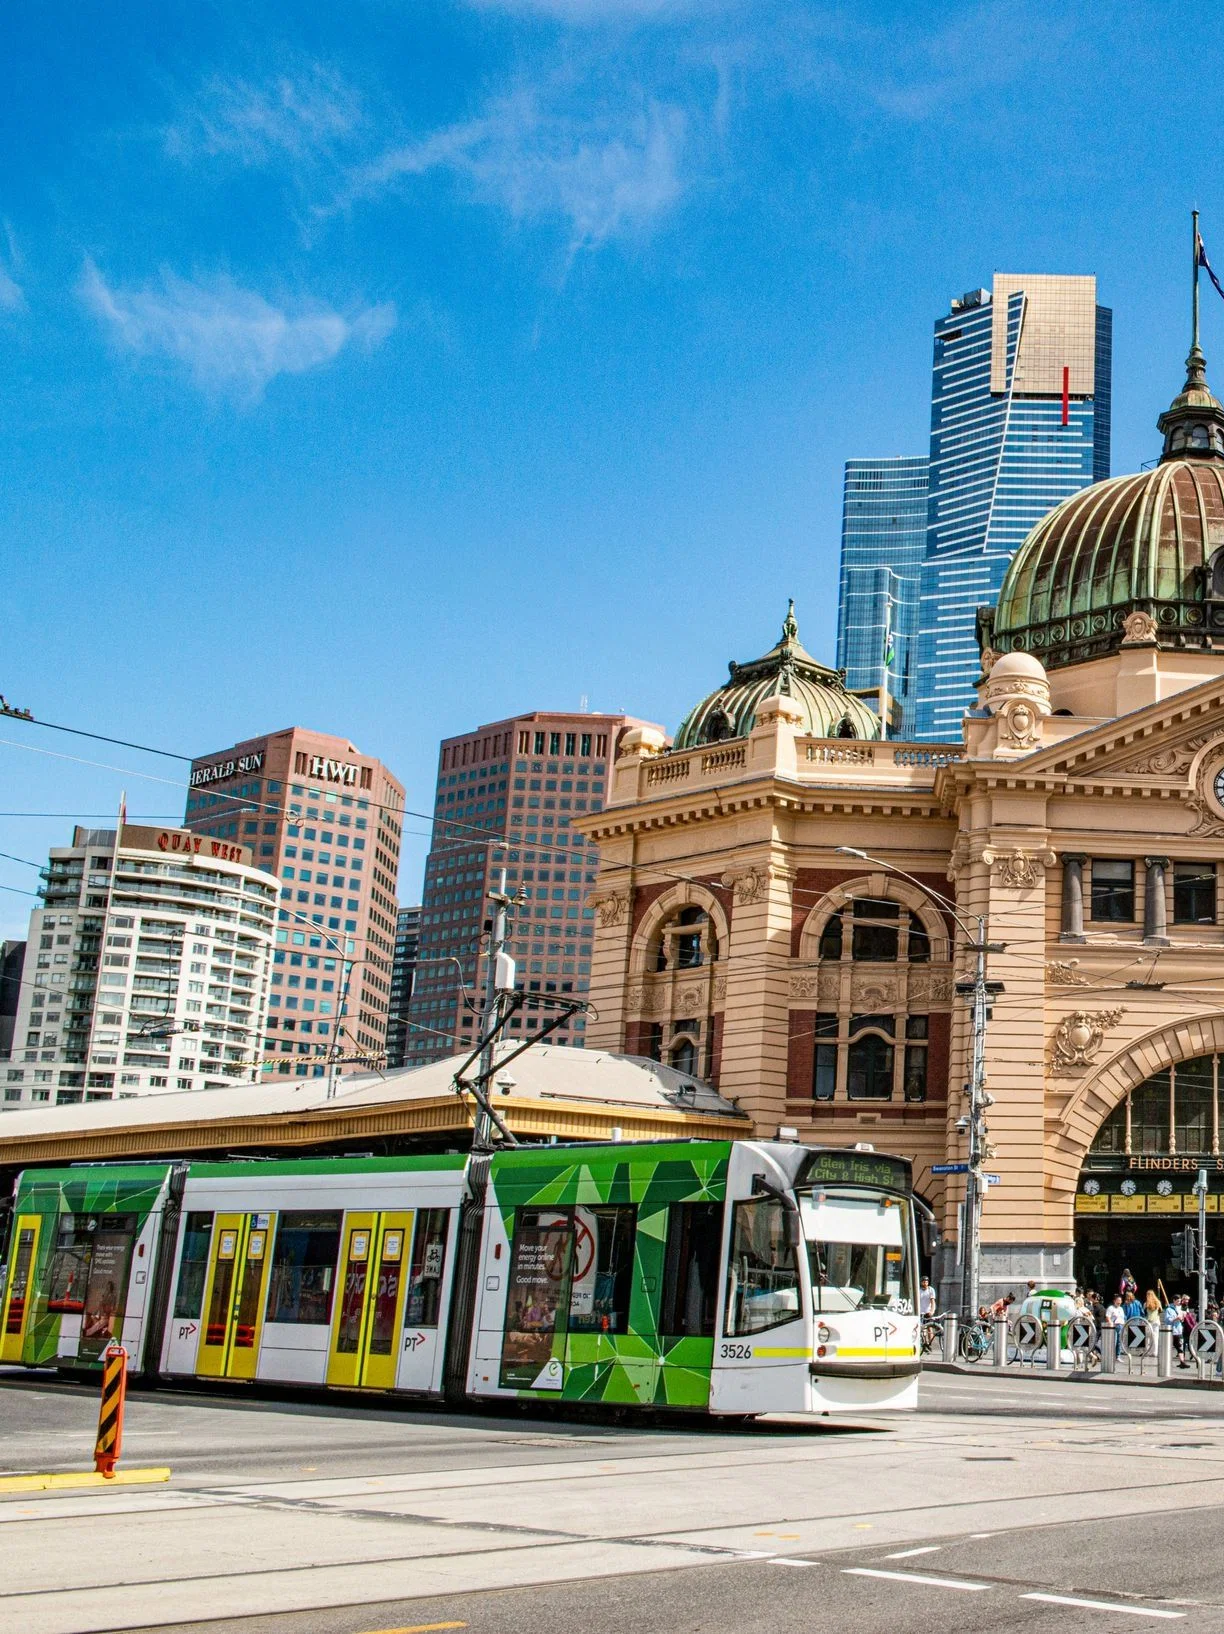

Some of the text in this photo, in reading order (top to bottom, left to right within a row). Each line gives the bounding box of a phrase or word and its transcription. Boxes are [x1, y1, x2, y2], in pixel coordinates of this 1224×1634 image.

[190, 753, 263, 786] HERALD SUN
[312, 757, 359, 783] HWT
[158, 833, 242, 863] QUAY WEST
[820, 1157, 891, 1174] Glen Iris via
[1129, 1158, 1198, 1170] FLINDERS
[814, 1168, 837, 1180] City
[854, 1172, 878, 1184] High
[882, 1175, 894, 1185] St
[519, 1244, 547, 1253] Move your
[518, 1253, 554, 1263] energy online
[516, 1276, 532, 1284] Good
[892, 1298, 913, 1313] 3526
[720, 1344, 751, 1359] 3526
